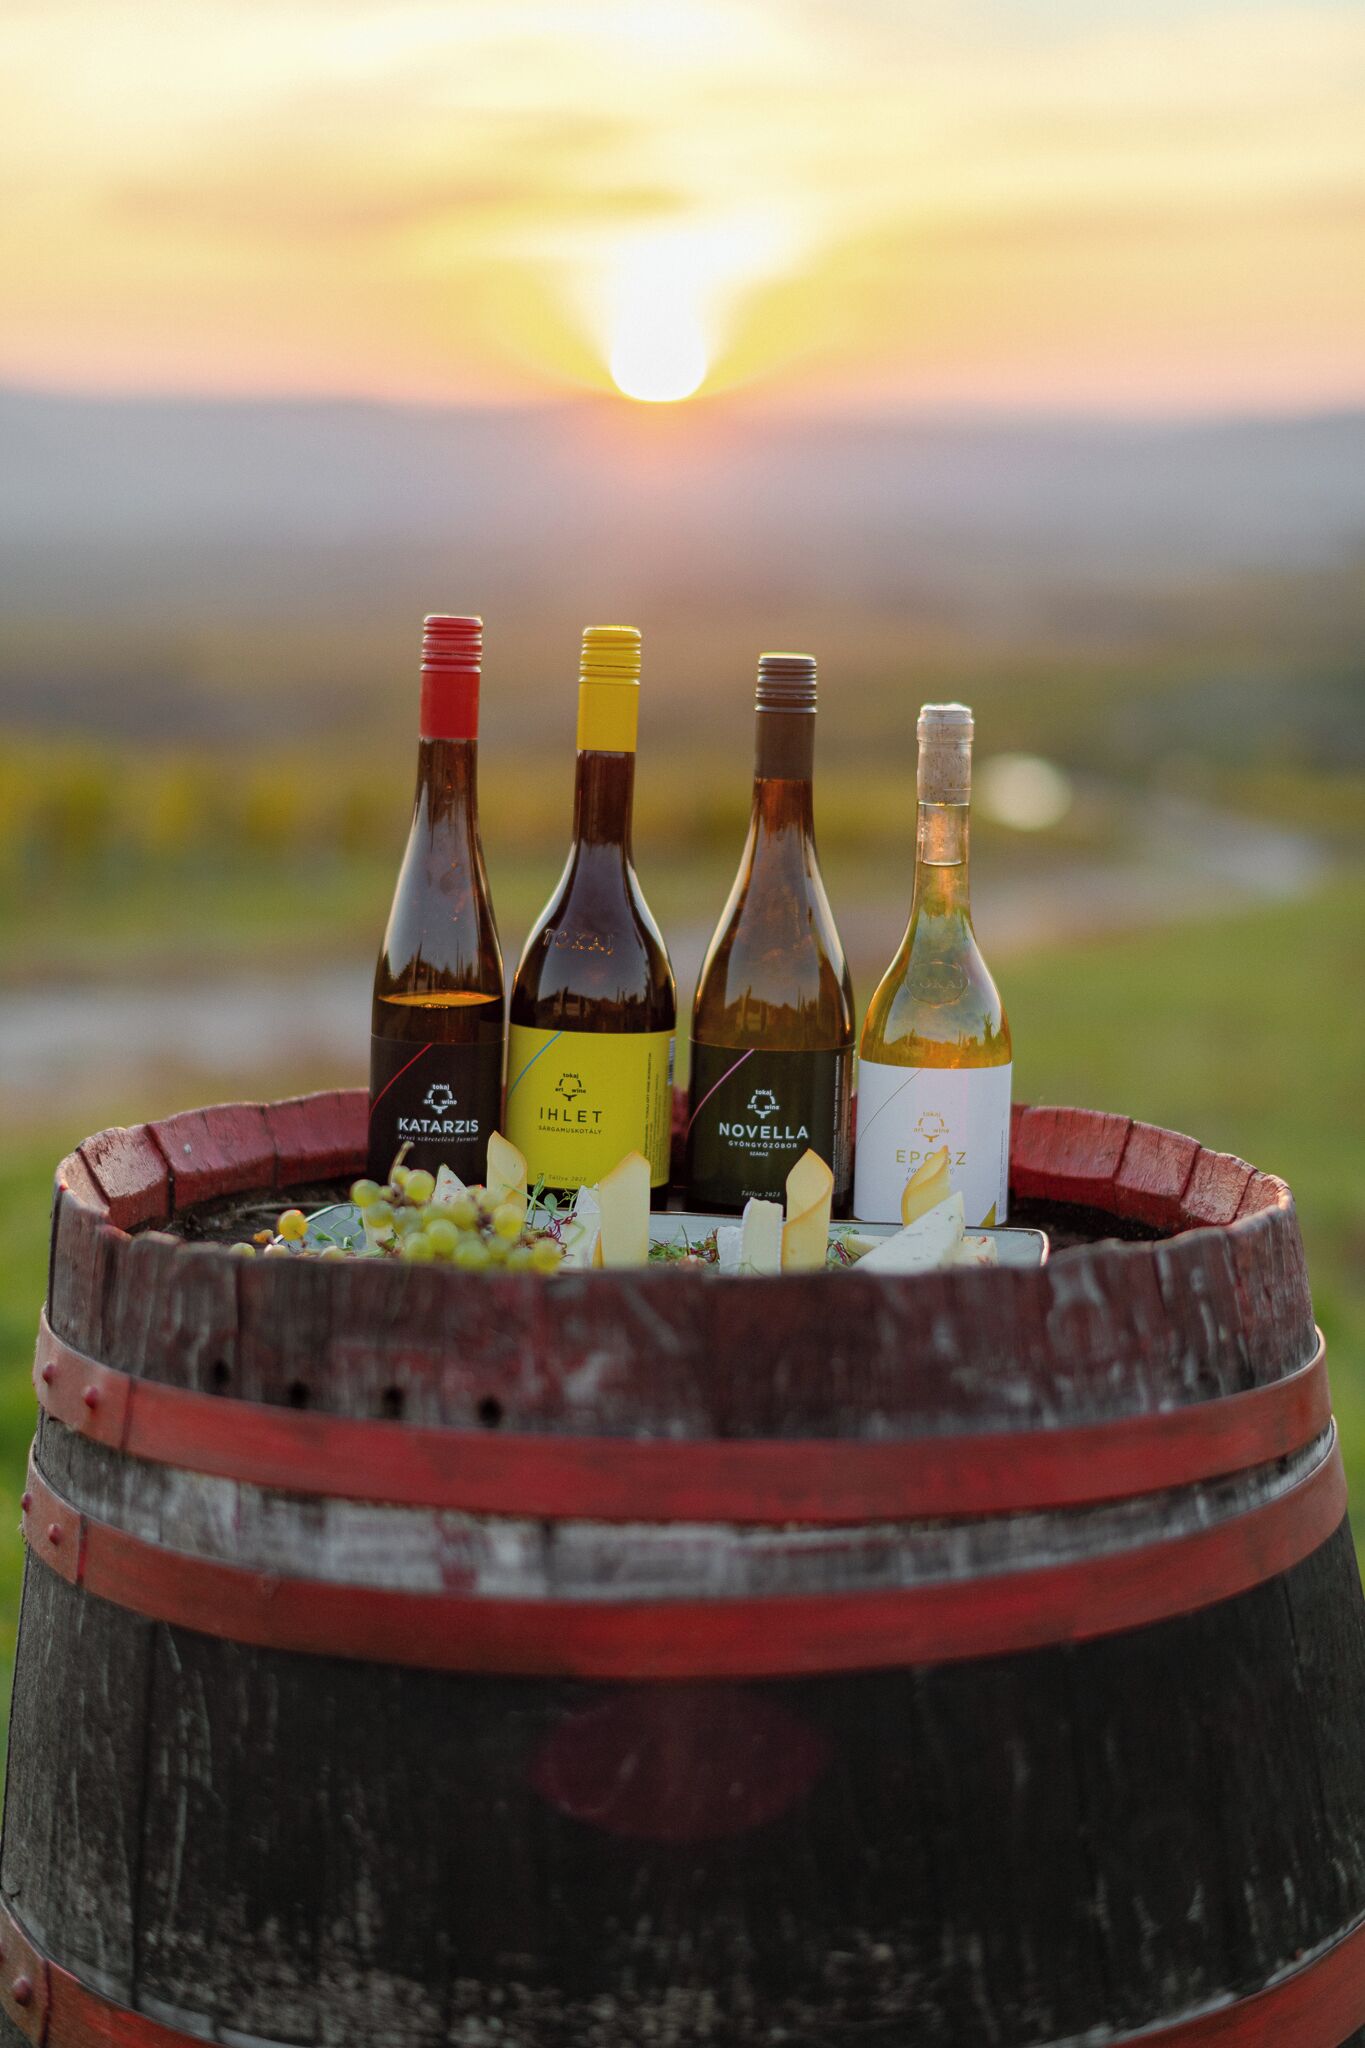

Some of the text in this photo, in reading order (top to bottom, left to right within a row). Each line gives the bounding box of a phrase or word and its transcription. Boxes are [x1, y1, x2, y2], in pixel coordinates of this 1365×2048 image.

[432, 1083, 450, 1091] tokaj
[540, 1106, 602, 1123] IHLET
[398, 1118, 479, 1133] KATARZIS
[719, 1122, 809, 1139] NOVELLA
[896, 1149, 967, 1165] EPZ
